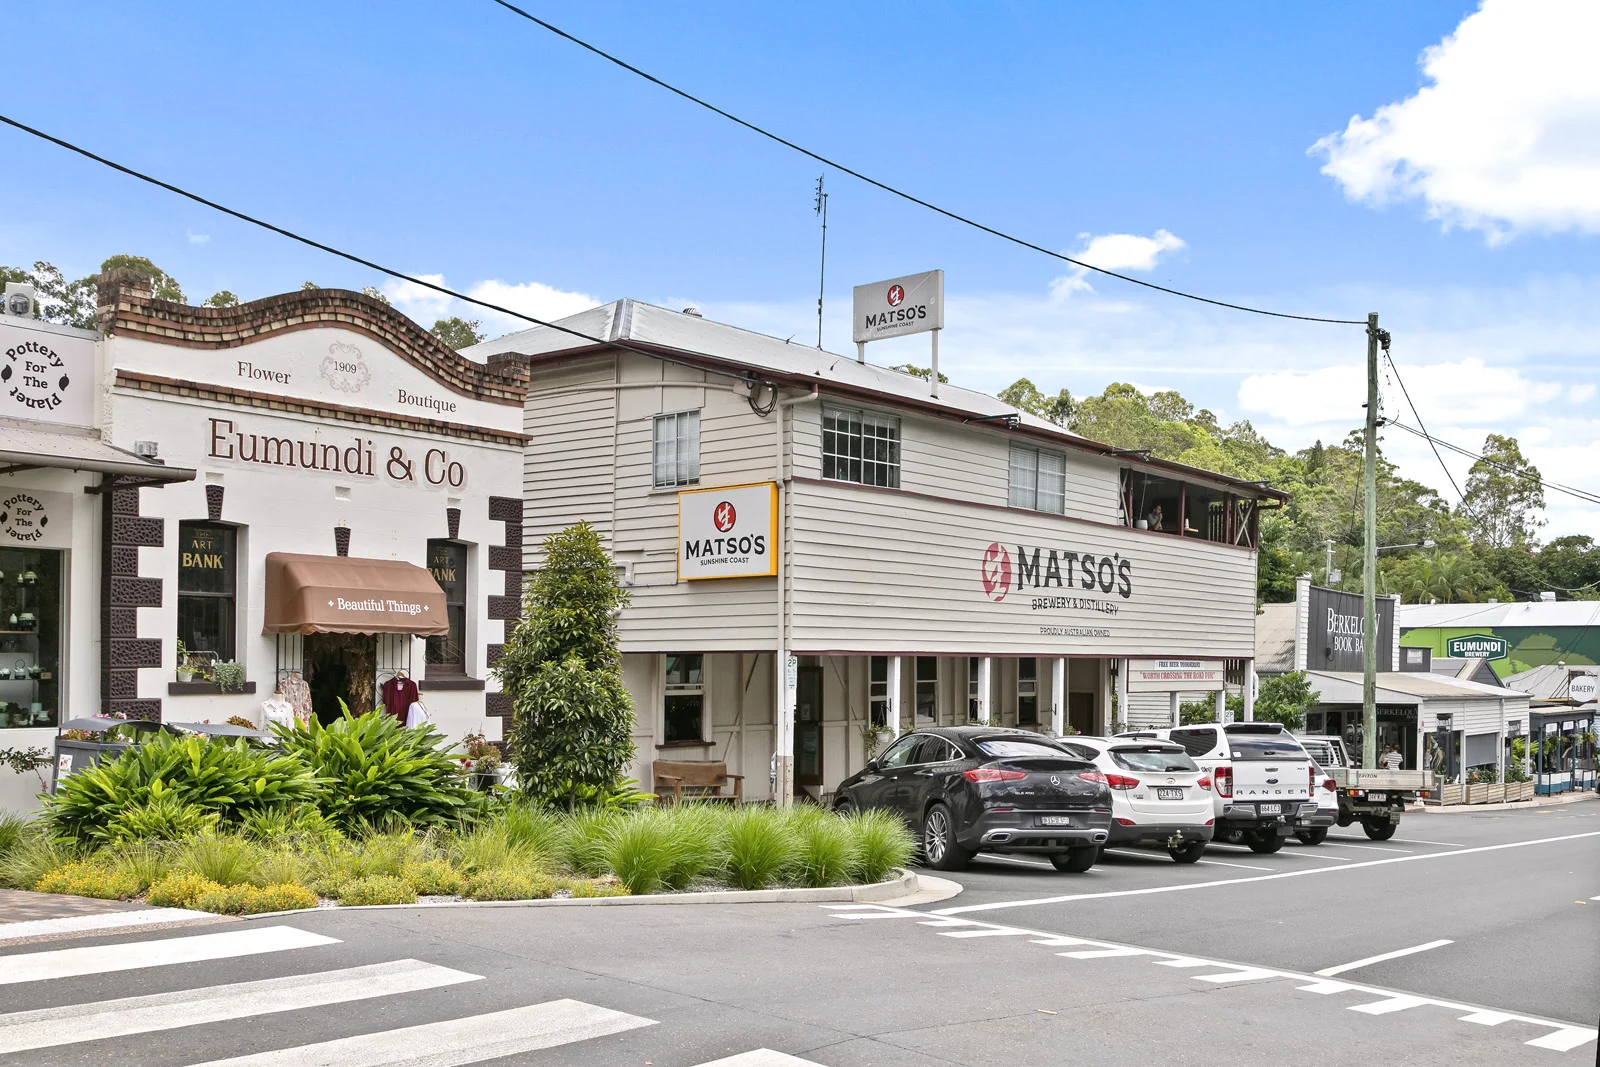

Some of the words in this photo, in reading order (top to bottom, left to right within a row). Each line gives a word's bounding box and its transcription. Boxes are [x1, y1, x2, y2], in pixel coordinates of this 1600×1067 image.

[865, 305, 926, 329] MATSO'S
[876, 323, 898, 332] SUNSHINE
[5, 341, 65, 367] Pottery
[25, 360, 47, 373] For
[237, 361, 291, 384] Flower
[333, 360, 357, 374] 1909
[23, 375, 48, 389] The
[9, 386, 62, 411] Planet
[397, 389, 457, 414] Boutique
[208, 418, 375, 476] Eumundi
[386, 446, 413, 481] &
[424, 448, 464, 488] Co
[3, 494, 44, 510] Pottery
[16, 507, 32, 516] For
[15, 518, 33, 527] The
[192, 539, 213, 550] ART
[685, 533, 765, 560] MATSO'S
[182, 552, 223, 569] BANK
[433, 556, 449, 565] ART
[700, 557, 728, 566] SUNSHINE
[1017, 545, 1132, 599] MATSO'S
[336, 597, 385, 611] Beautiful
[386, 600, 421, 616] Things
[1031, 597, 1072, 611] BREWERY
[1073, 598, 1078, 609] &
[1079, 599, 1119, 616] DISTILLERY
[1039, 626, 1063, 636] PROUDLY
[1063, 628, 1093, 637] AUSTRALIAN
[1094, 629, 1110, 637] OWNED
[1334, 636, 1353, 652] BOOK
[1453, 641, 1501, 652] EUMUNDI
[1160, 671, 1183, 680] CROSSING
[1183, 671, 1193, 680] THE
[1571, 684, 1596, 693] BAKERY
